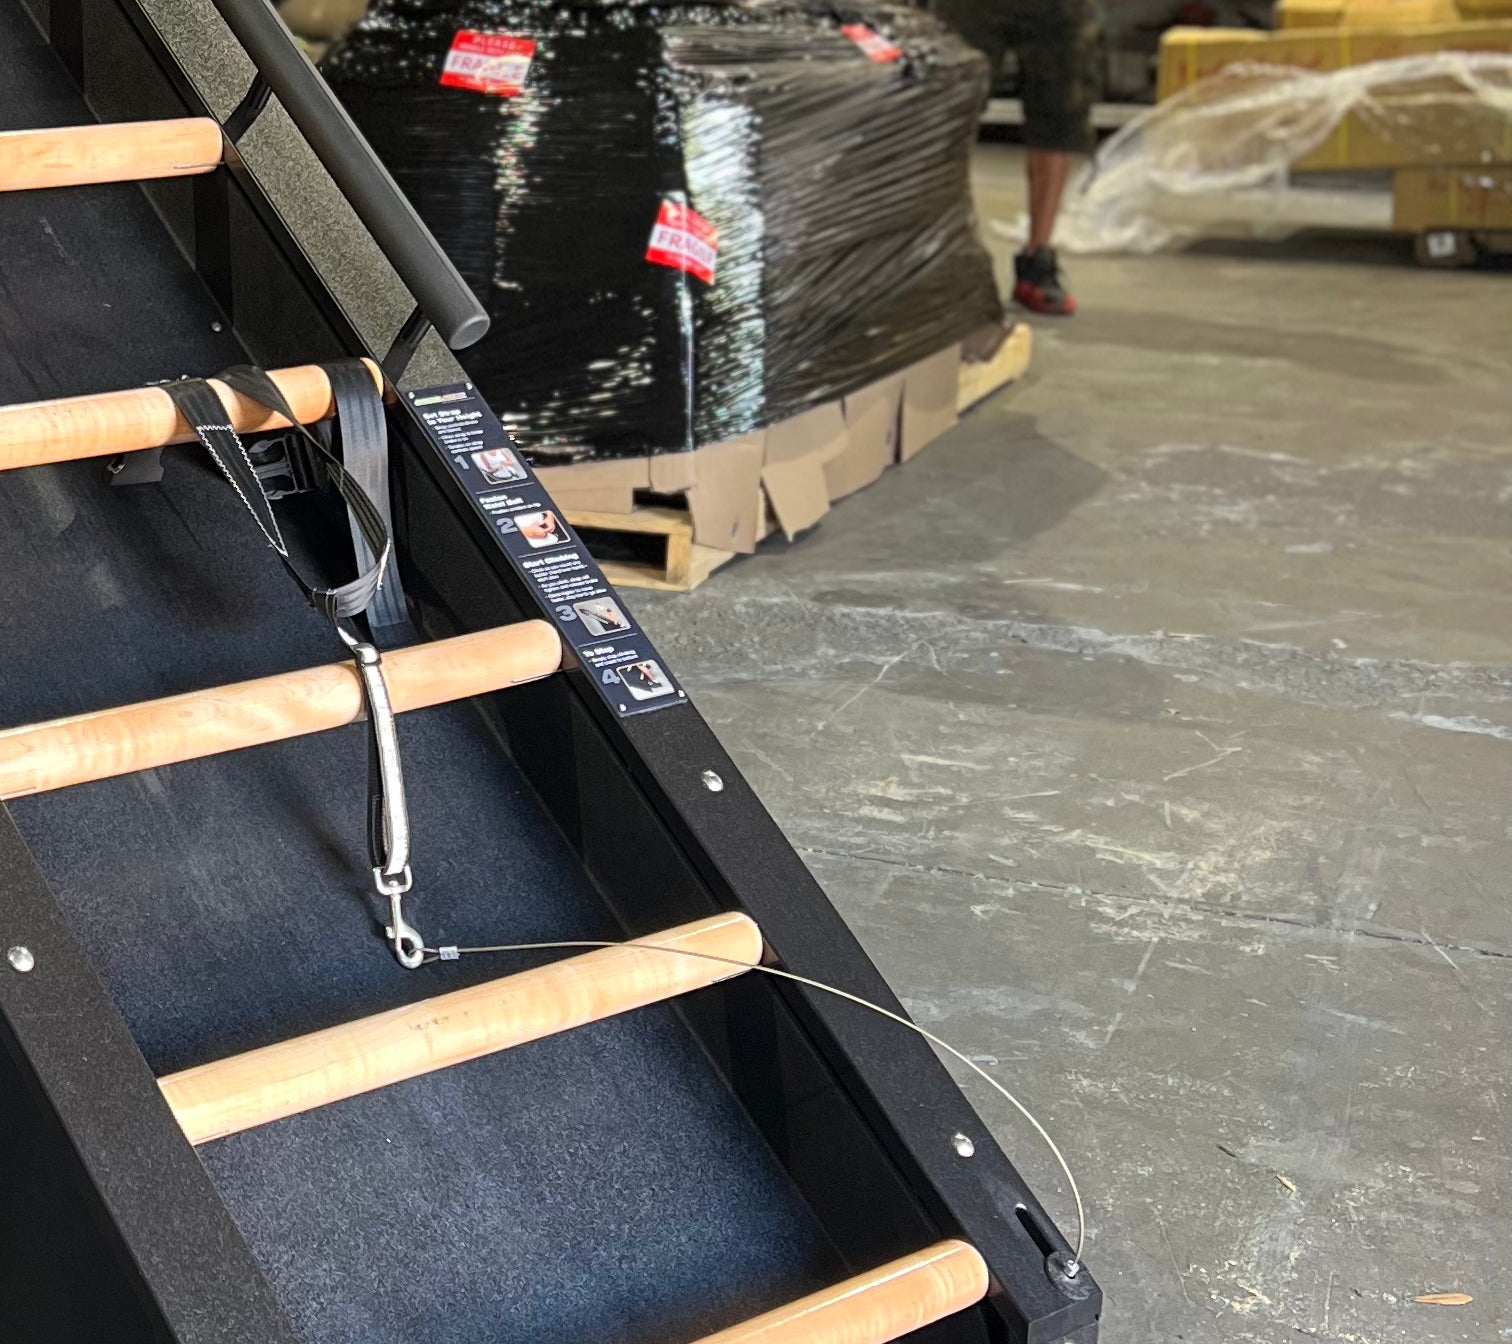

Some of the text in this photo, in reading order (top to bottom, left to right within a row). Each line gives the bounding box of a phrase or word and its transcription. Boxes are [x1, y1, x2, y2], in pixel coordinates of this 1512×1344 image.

[450, 54, 524, 80] FRAE
[454, 455, 470, 470] 1
[496, 518, 519, 534] 2
[555, 605, 578, 622] 3
[602, 668, 620, 685] 4
